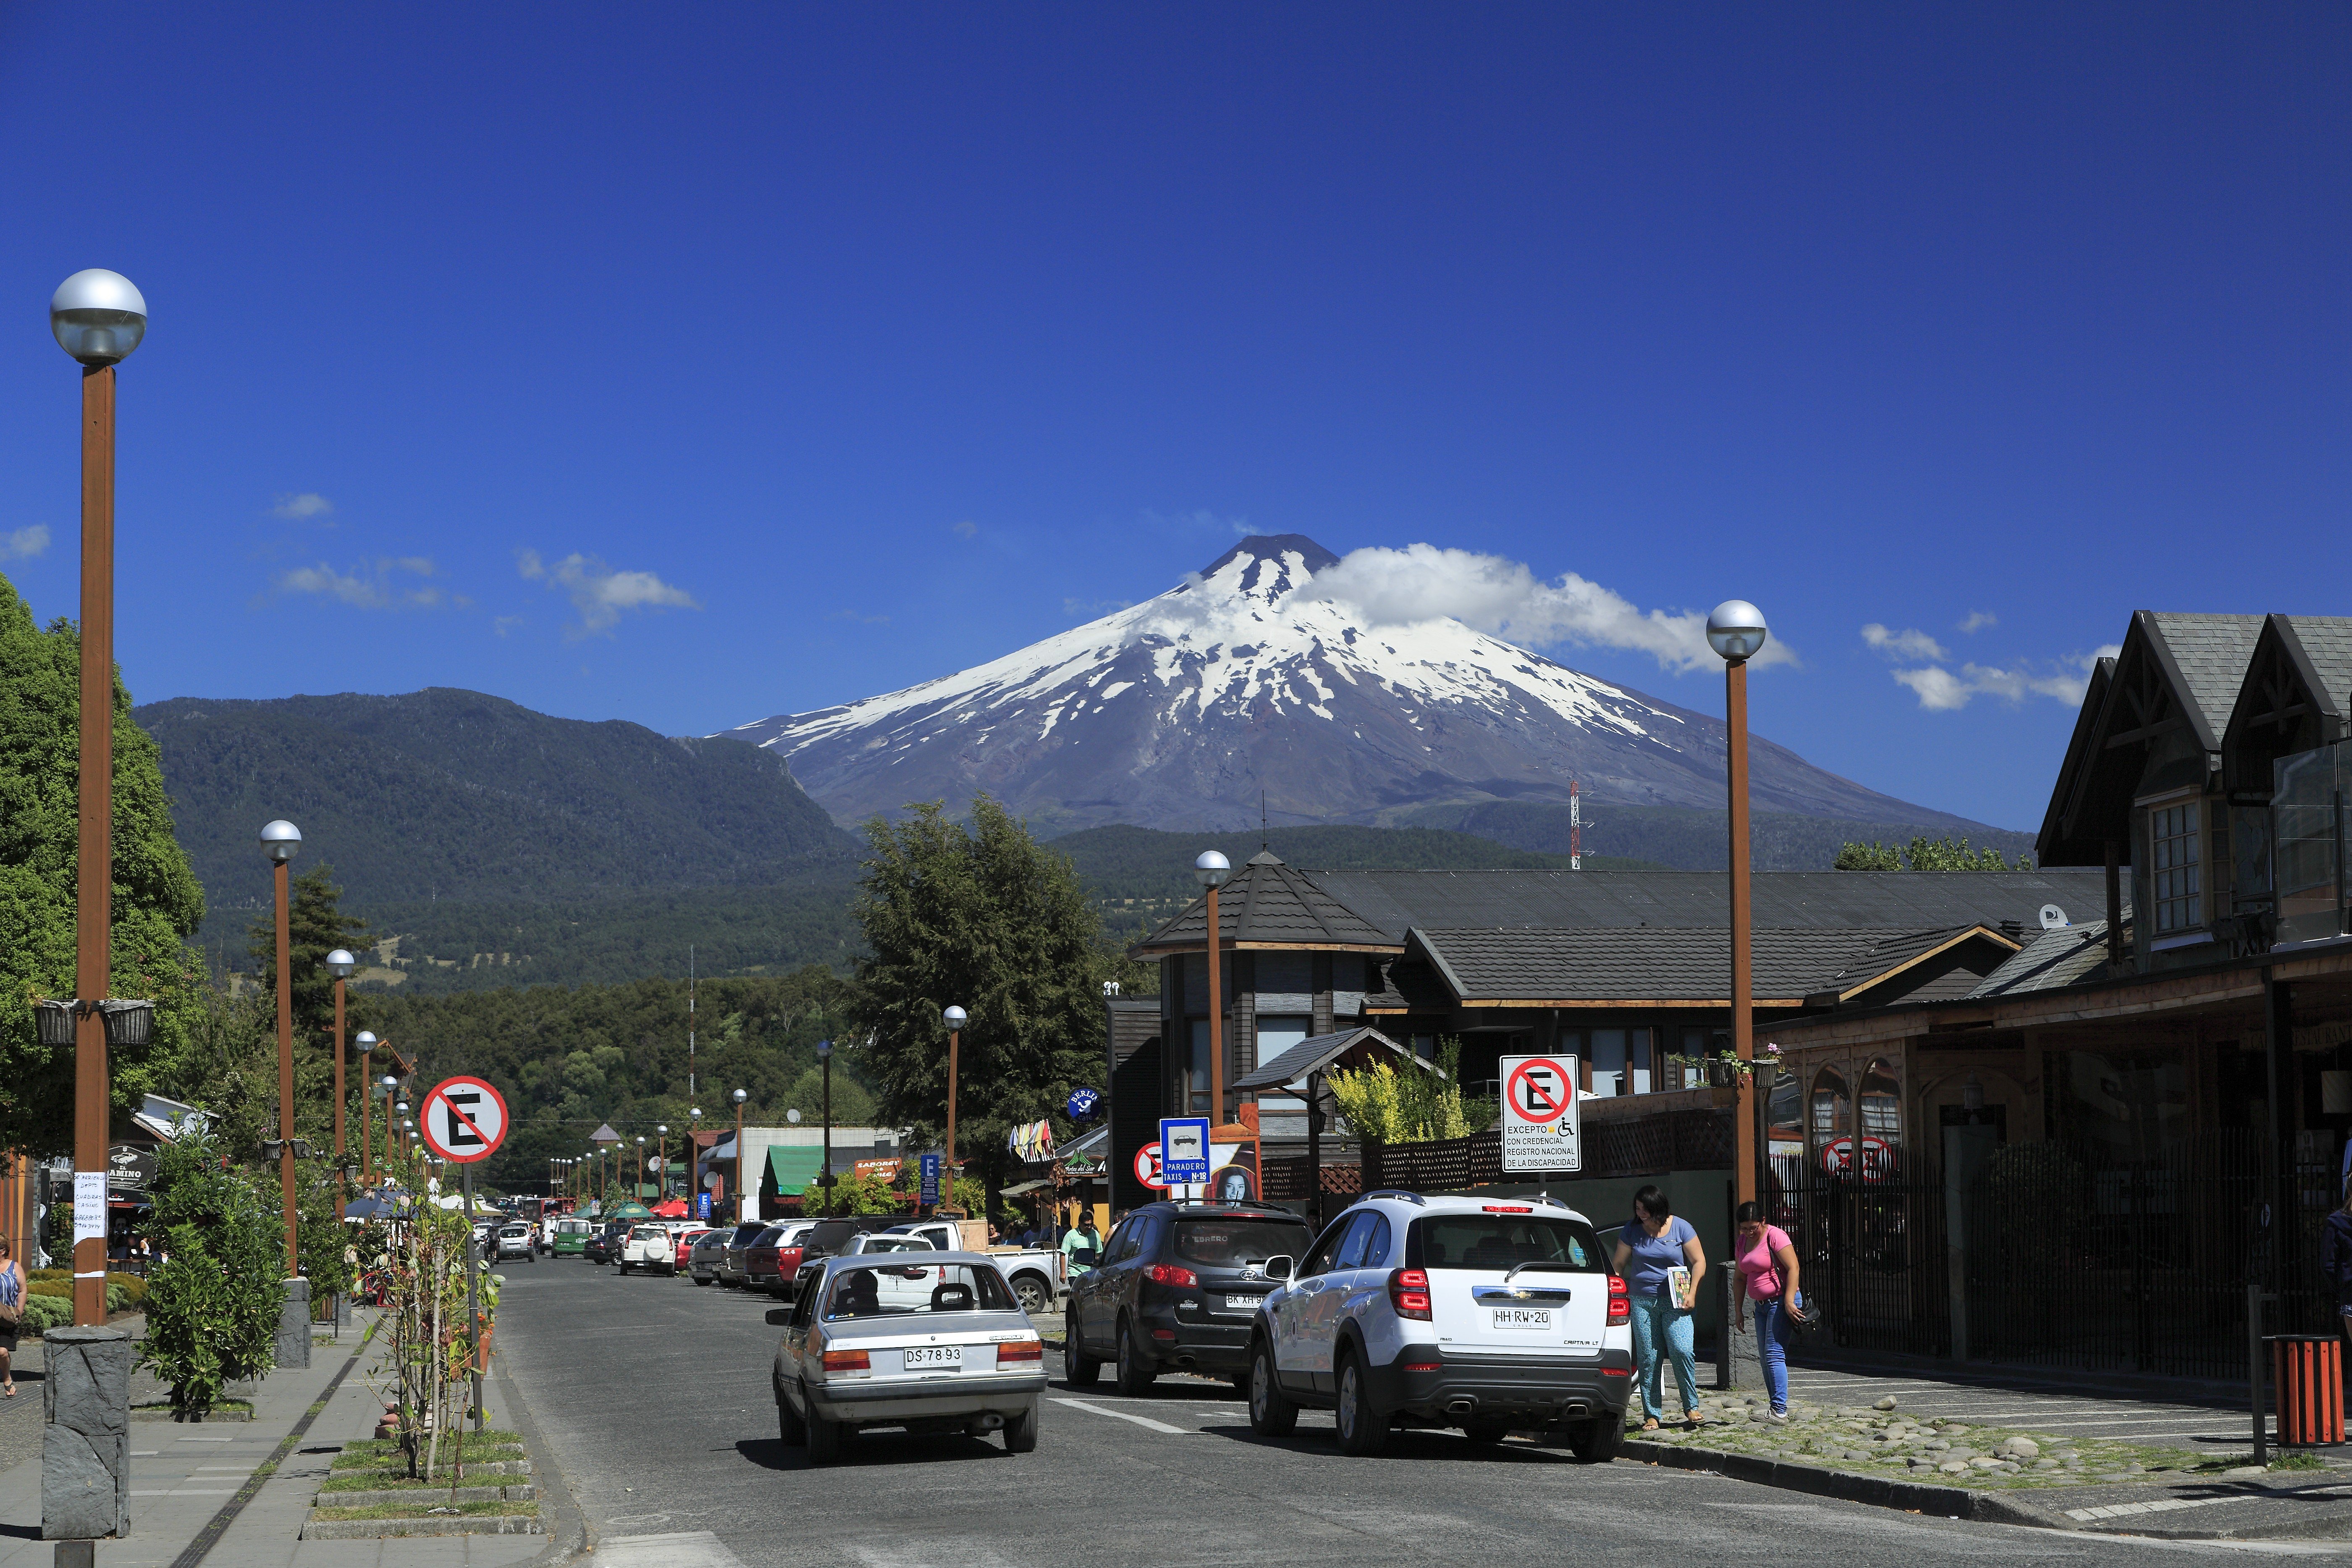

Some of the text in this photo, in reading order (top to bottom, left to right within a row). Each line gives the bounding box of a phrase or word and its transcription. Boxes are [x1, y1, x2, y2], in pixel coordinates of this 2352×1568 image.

[1071, 1090, 1097, 1103] BERLIN
[1526, 1072, 1553, 1109] E
[446, 1093, 483, 1146] E
[109, 1169, 141, 1178] AMINO
[927, 1159, 933, 1176] E
[702, 1196, 707, 1204] E
